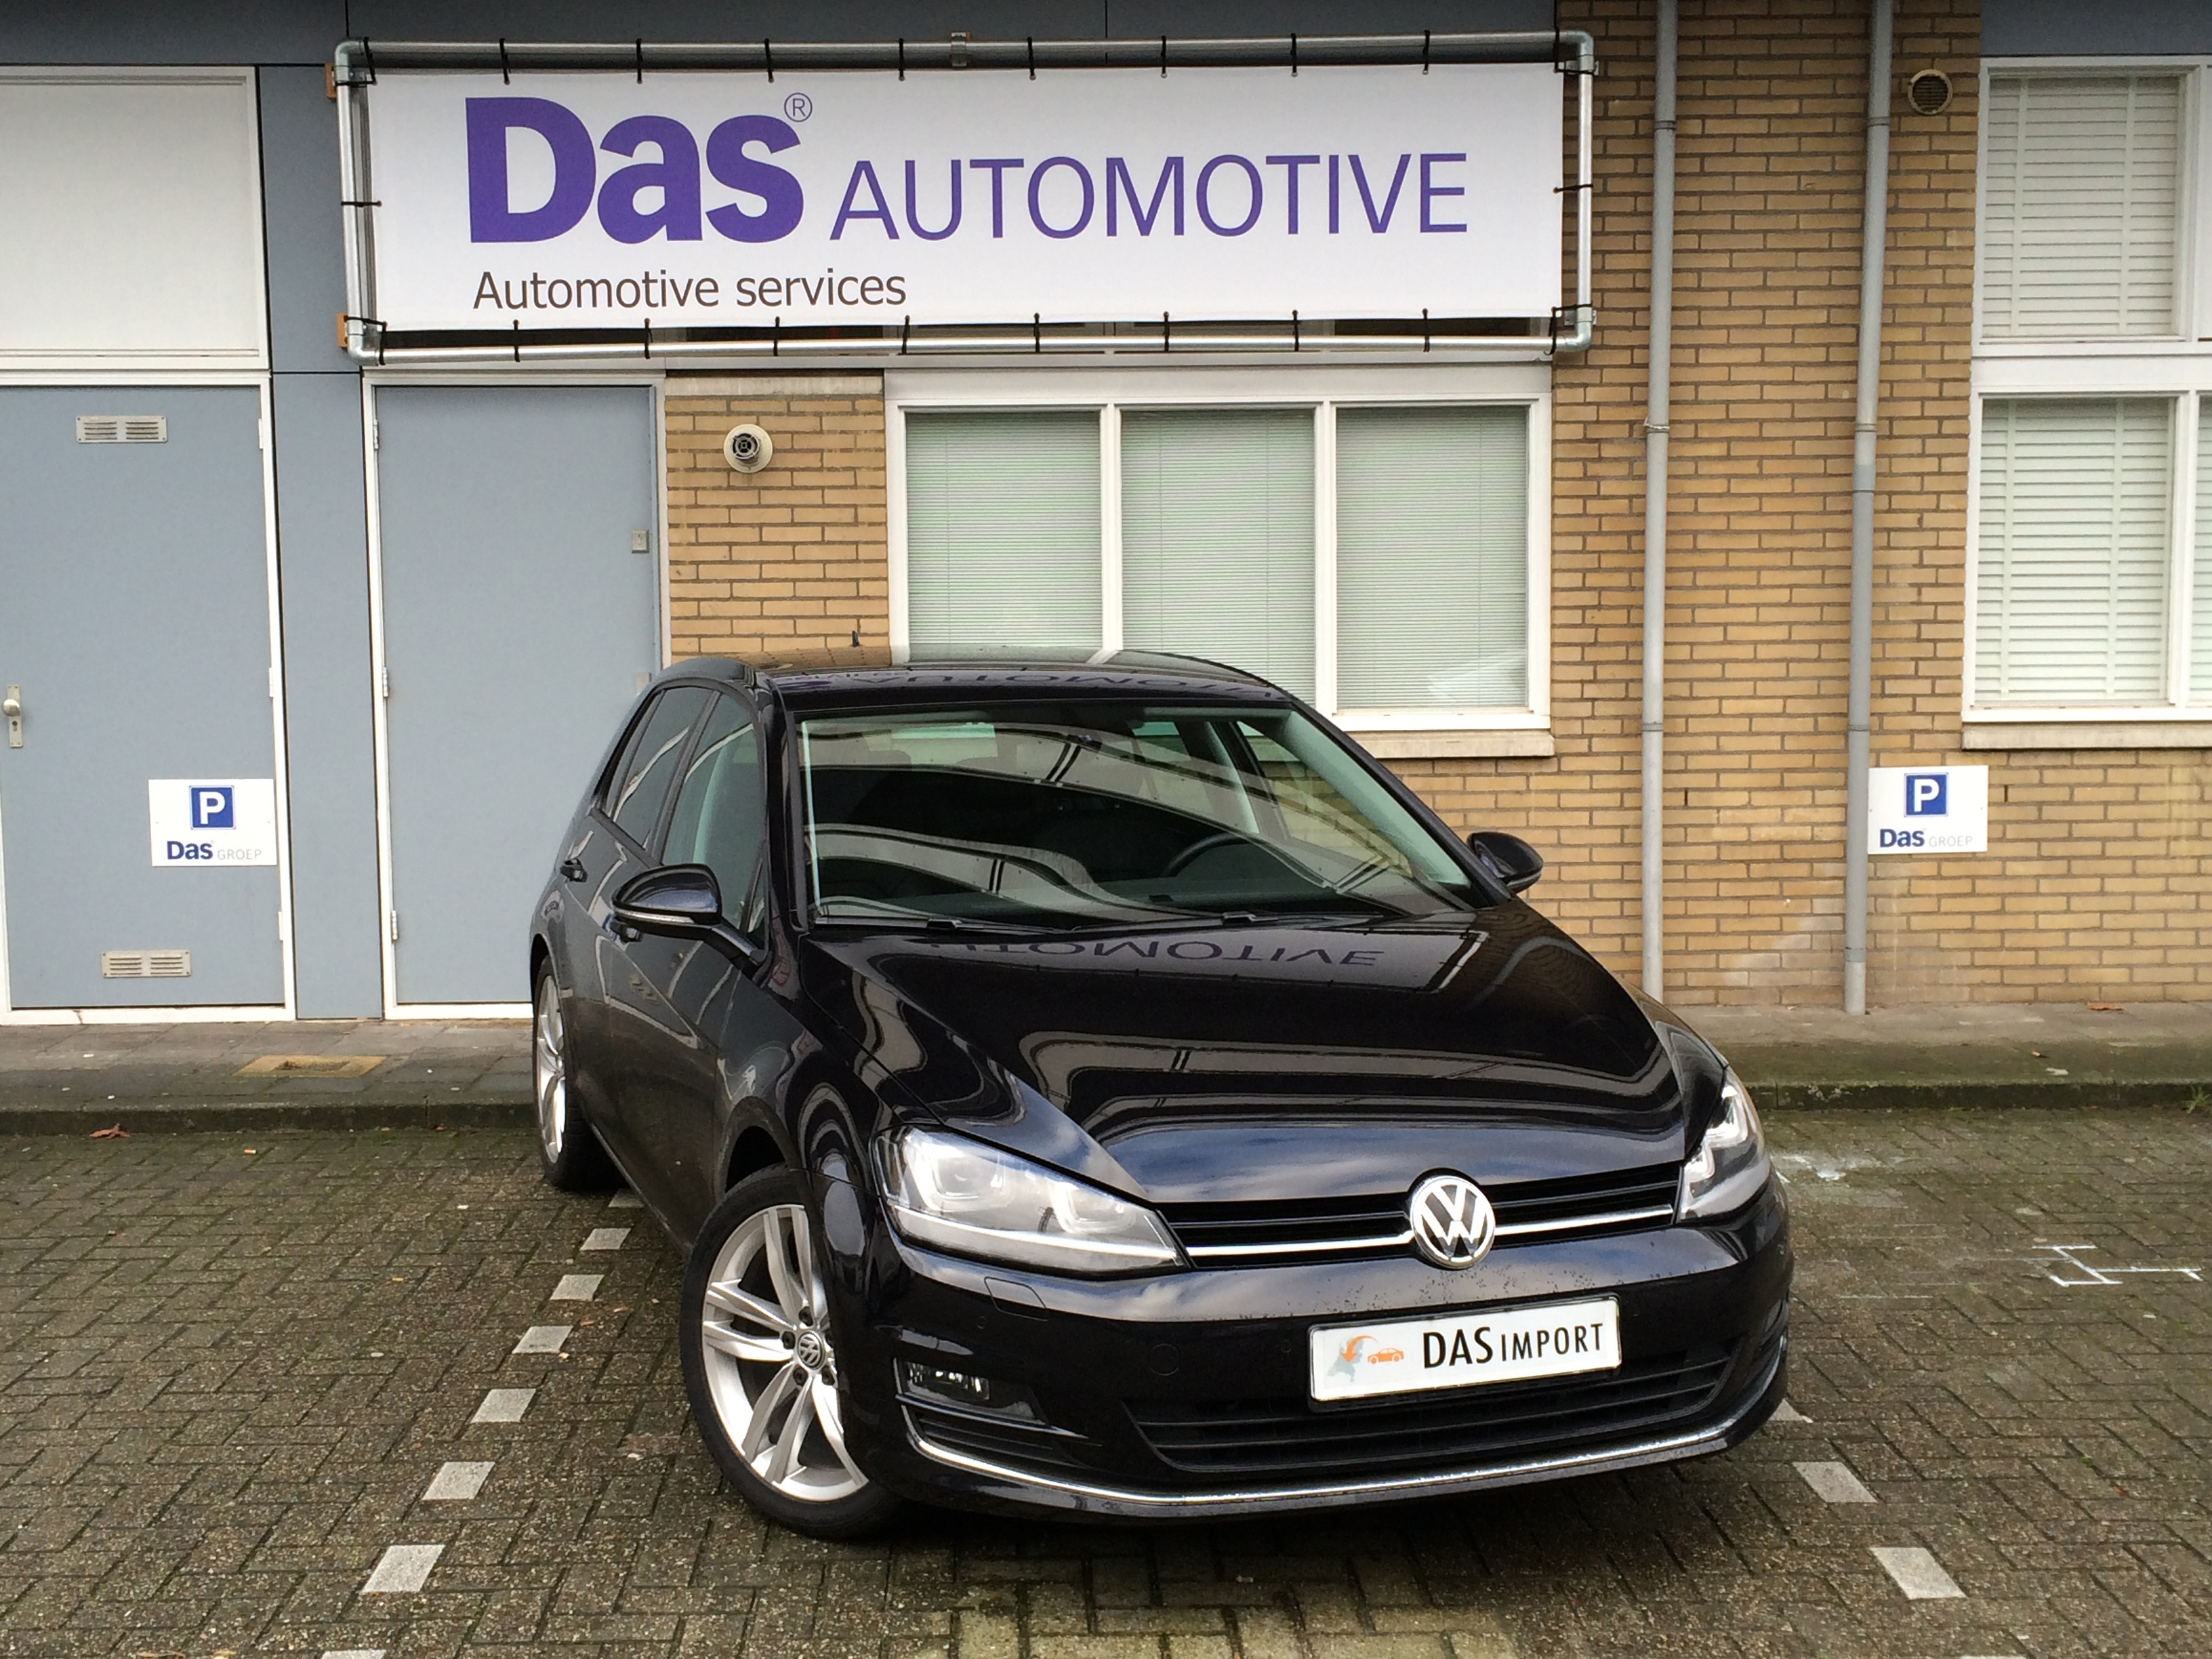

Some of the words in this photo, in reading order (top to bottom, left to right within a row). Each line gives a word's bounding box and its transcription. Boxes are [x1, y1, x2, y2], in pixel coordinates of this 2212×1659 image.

[829, 152, 1469, 241] AUTOMOTIVE
[473, 268, 720, 310] Automotive
[735, 267, 907, 308] services
[167, 840, 213, 860] Das
[217, 848, 262, 860] GROEP
[1879, 828, 1925, 848] Das
[1928, 835, 1973, 848] GROEP
[1422, 1326, 1494, 1369] DAS
[1501, 1322, 1603, 1362] IMPORT
